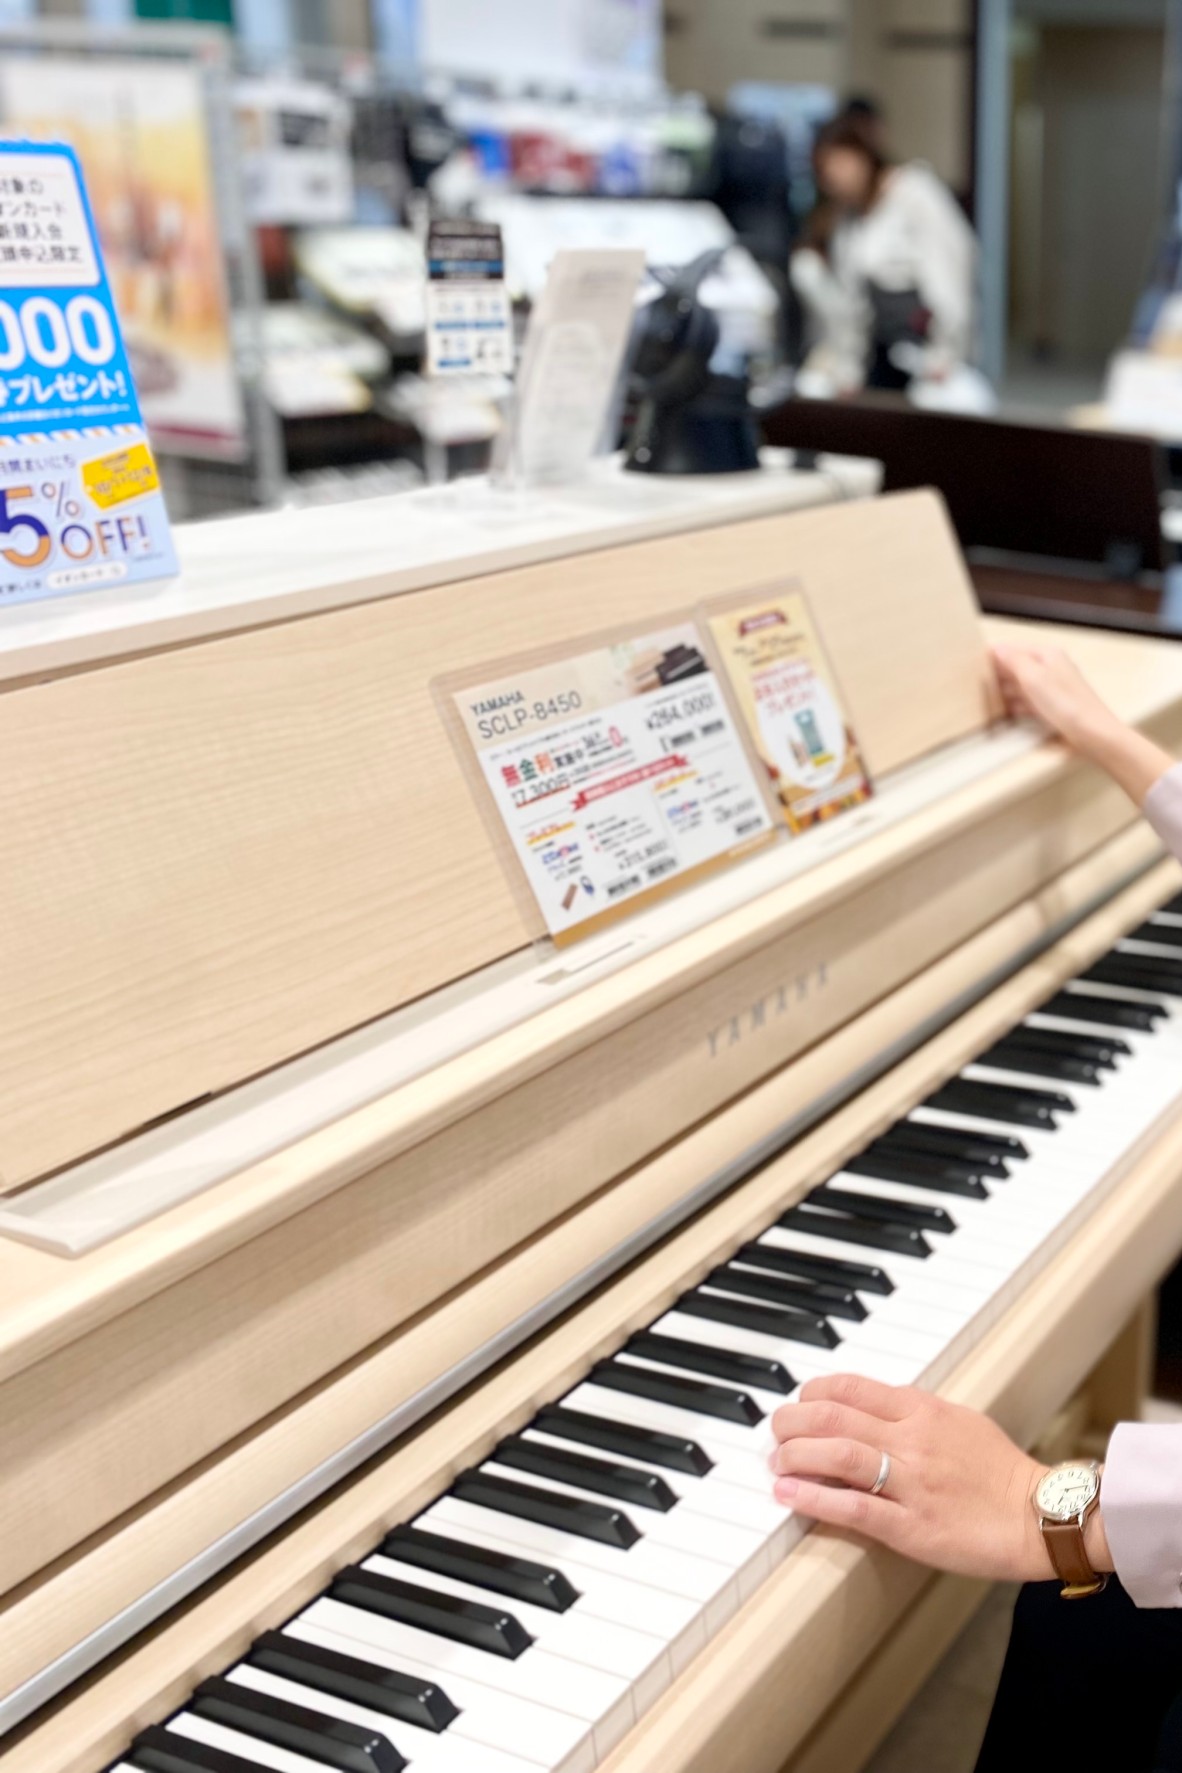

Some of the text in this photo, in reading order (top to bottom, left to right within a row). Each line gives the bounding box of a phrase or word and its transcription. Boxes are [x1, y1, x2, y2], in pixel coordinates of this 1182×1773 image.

[470, 691, 525, 716] YAMAHA
[477, 690, 583, 740] SCLP-8450
[707, 962, 828, 1057] YAMAHA
